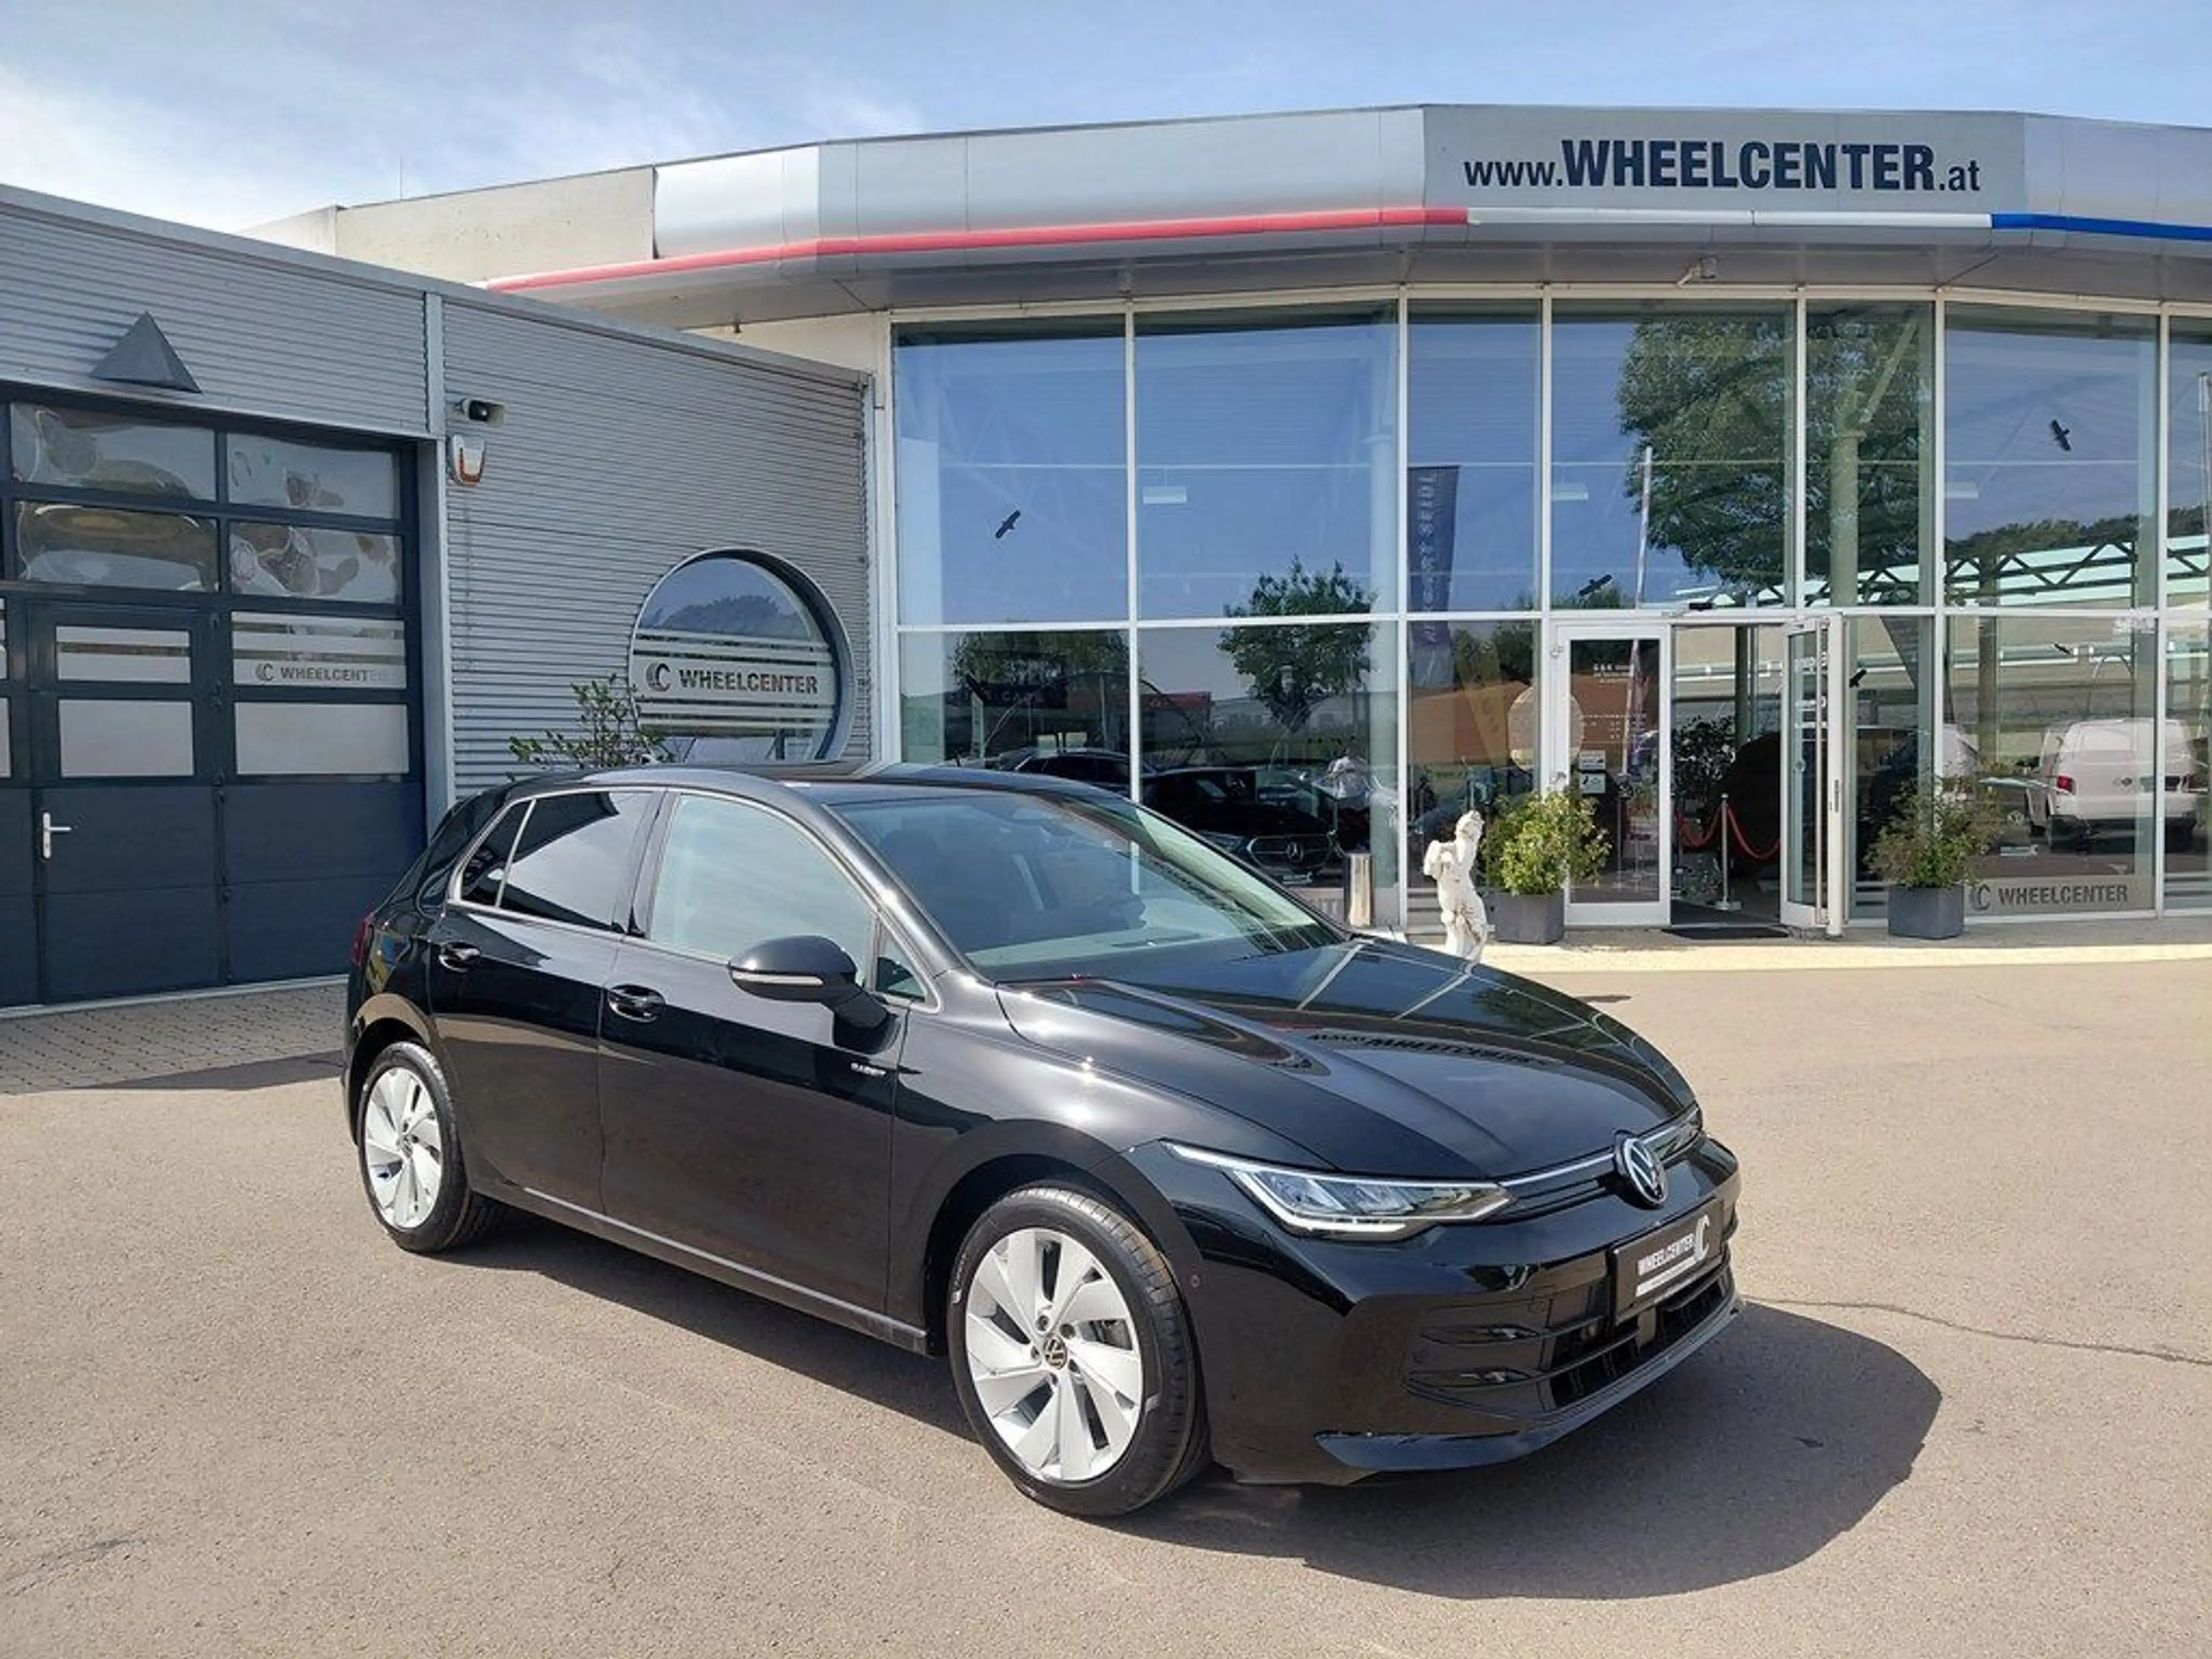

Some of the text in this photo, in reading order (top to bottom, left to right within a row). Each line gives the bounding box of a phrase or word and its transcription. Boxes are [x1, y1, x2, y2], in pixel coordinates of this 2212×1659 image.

[1464, 139, 1980, 191] www.WHEELCENTER.at
[679, 669, 818, 694] WHEELCENTER
[1998, 884, 2128, 906] WHEELCENTER
